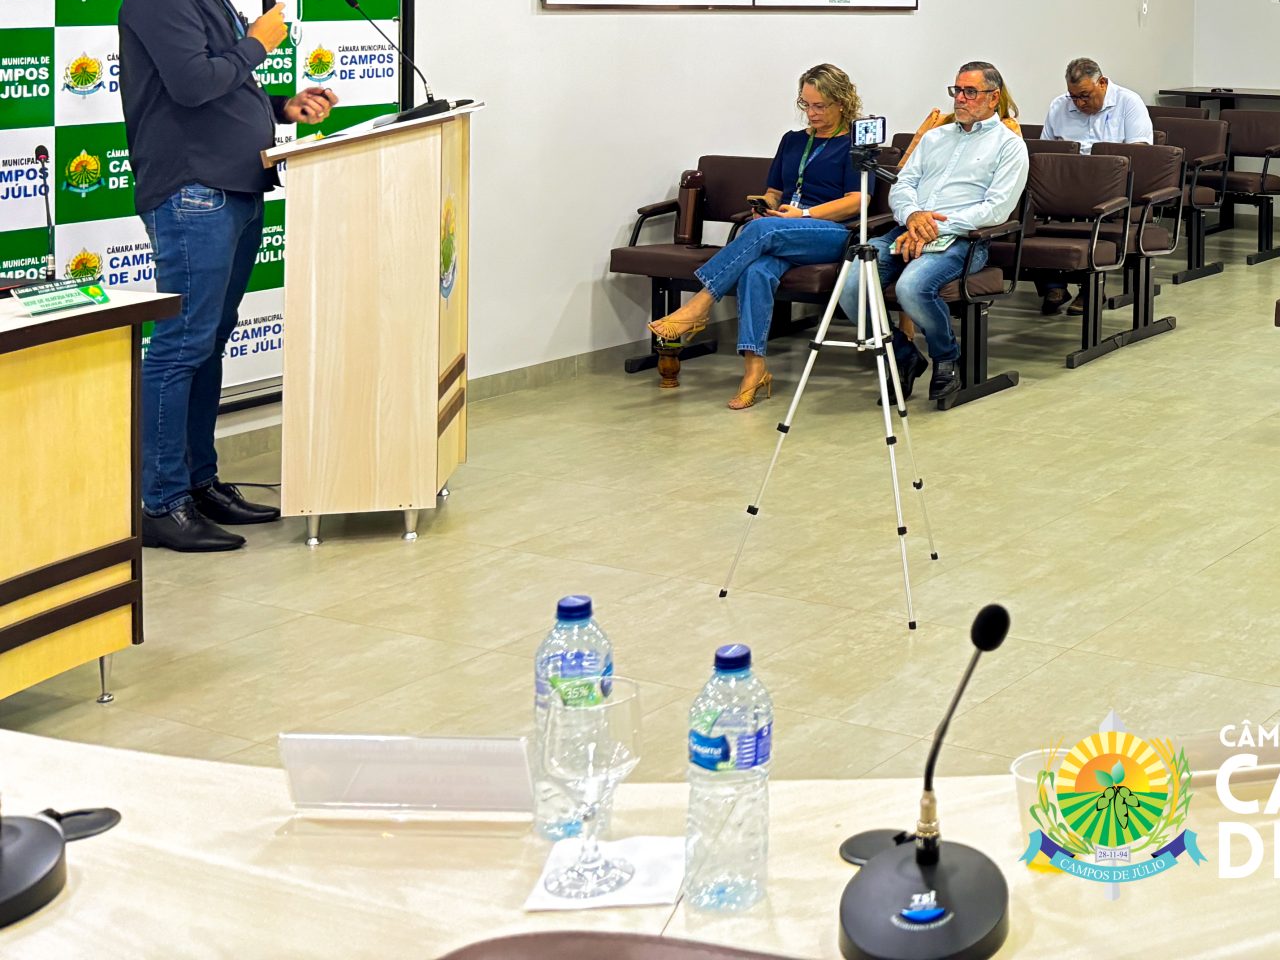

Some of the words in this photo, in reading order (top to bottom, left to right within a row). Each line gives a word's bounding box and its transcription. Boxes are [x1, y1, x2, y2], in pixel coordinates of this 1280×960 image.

[2, 57, 38, 66] MUNICIPAL
[41, 56, 50, 64] DE
[340, 54, 393, 65] CAMPOS
[0, 68, 49, 82] MPOS
[340, 70, 355, 80] DE
[360, 66, 394, 78] JÚLIO
[0, 82, 50, 98] JÚLIO
[106, 149, 129, 158] CÂMAR
[0, 168, 48, 182] MPOS
[109, 176, 128, 189] DE
[107, 244, 132, 254] CÂMARA
[3, 256, 40, 268] MUNICIPAL
[110, 252, 154, 268] CAMP
[0, 266, 46, 279] MPOS
[109, 272, 128, 285] DE
[254, 314, 283, 324] MUNICIPAL
[231, 324, 282, 342] CAMPO
[231, 344, 248, 358] DE
[252, 338, 282, 354] JÚLI
